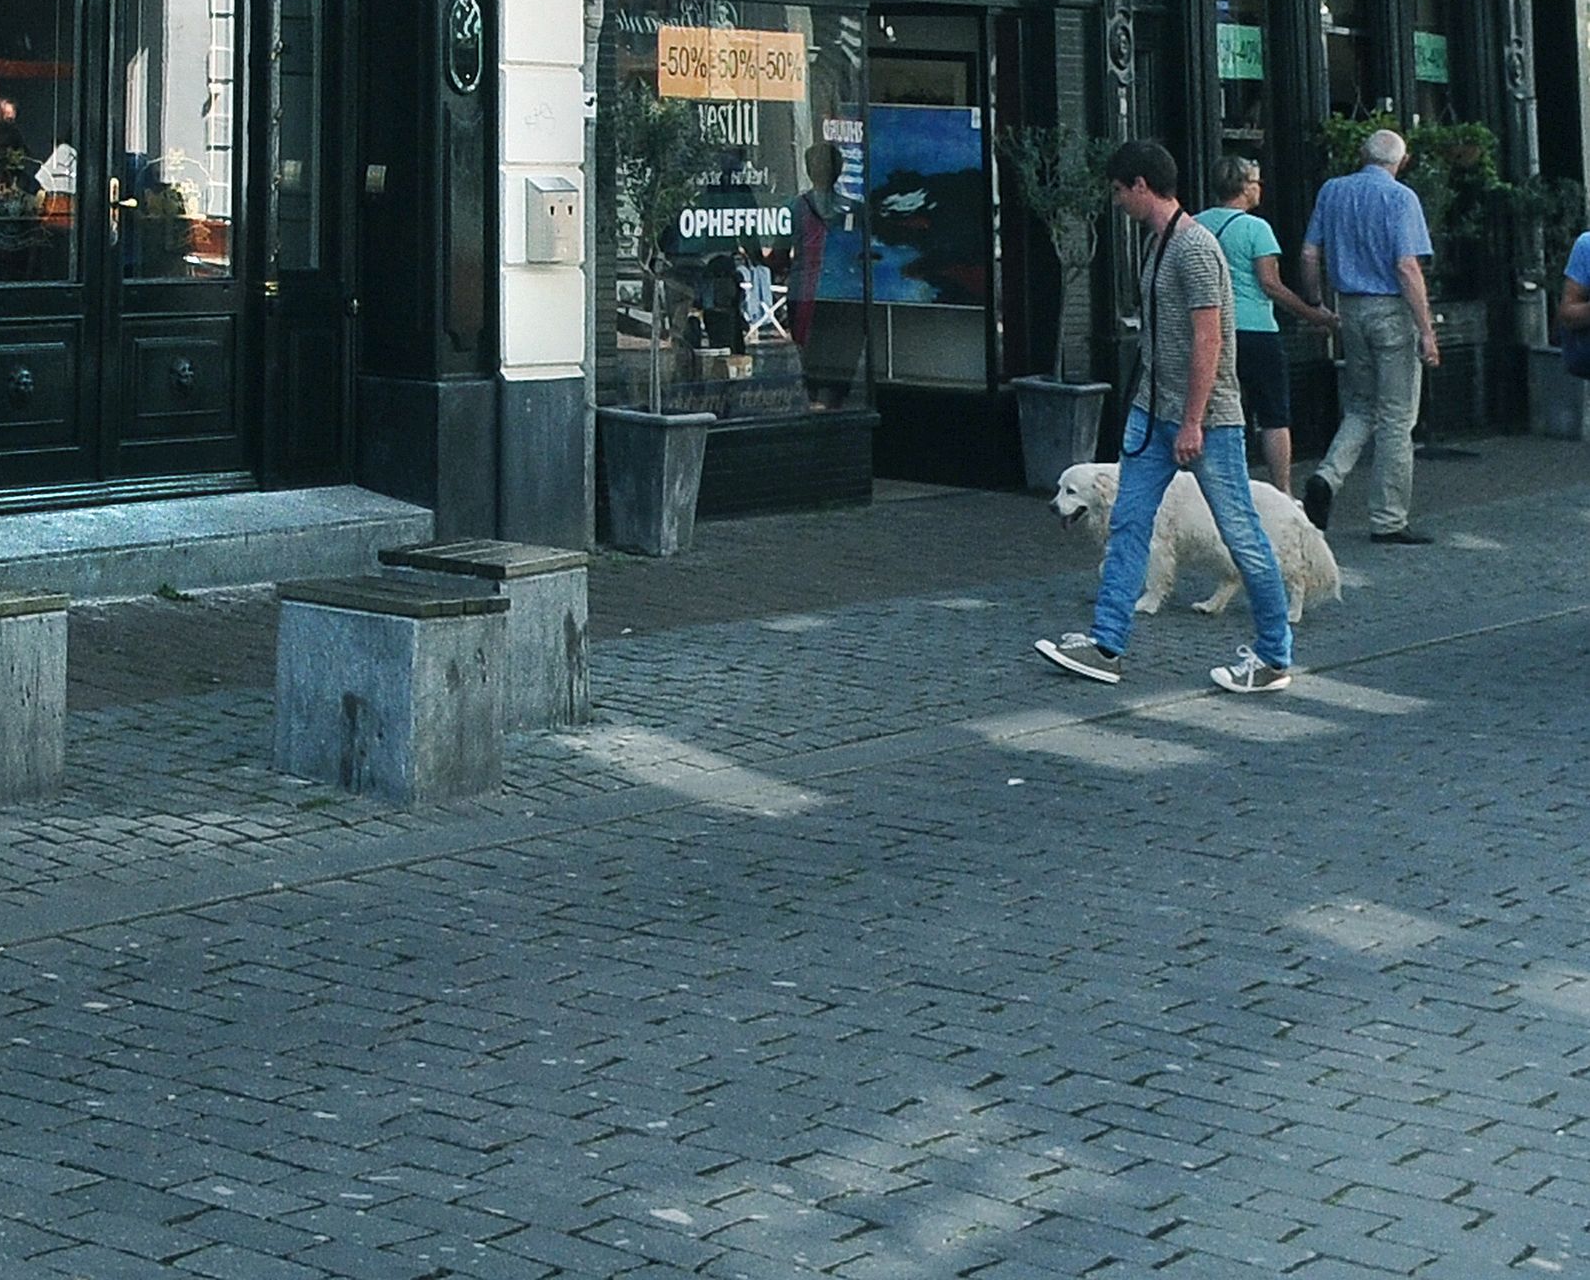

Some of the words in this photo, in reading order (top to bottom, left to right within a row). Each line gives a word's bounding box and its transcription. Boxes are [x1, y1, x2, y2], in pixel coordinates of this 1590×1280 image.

[661, 47, 707, 78] -50%
[711, 49, 756, 79] -50%
[760, 51, 802, 81] -50%
[679, 207, 792, 239] OPHEFFING
